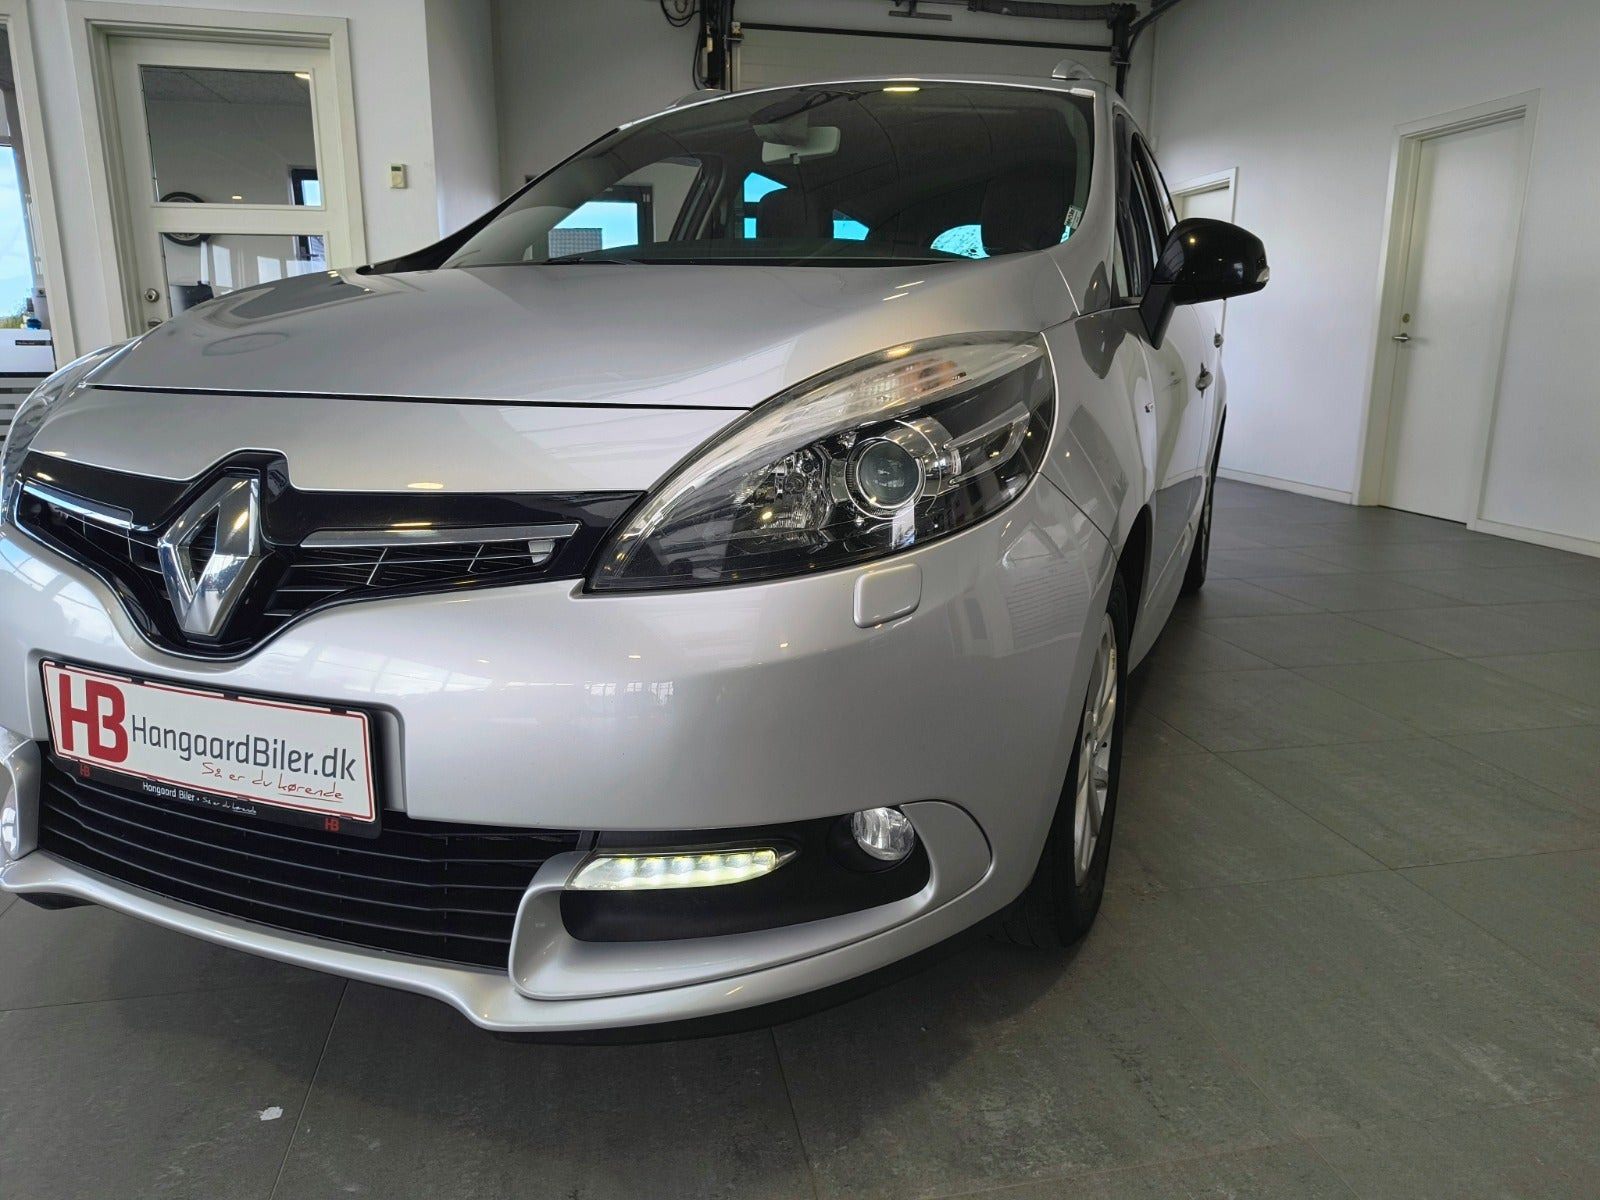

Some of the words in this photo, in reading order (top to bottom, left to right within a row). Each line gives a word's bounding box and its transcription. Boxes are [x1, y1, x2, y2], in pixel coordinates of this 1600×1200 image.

[59, 673, 129, 763] HB
[132, 714, 357, 782] HangaardBiler.dk
[178, 790, 196, 802] Biler
[202, 761, 223, 779] Så
[229, 772, 246, 782] er
[252, 769, 272, 787] du
[277, 773, 344, 800] kørende
[324, 817, 340, 832] HB
